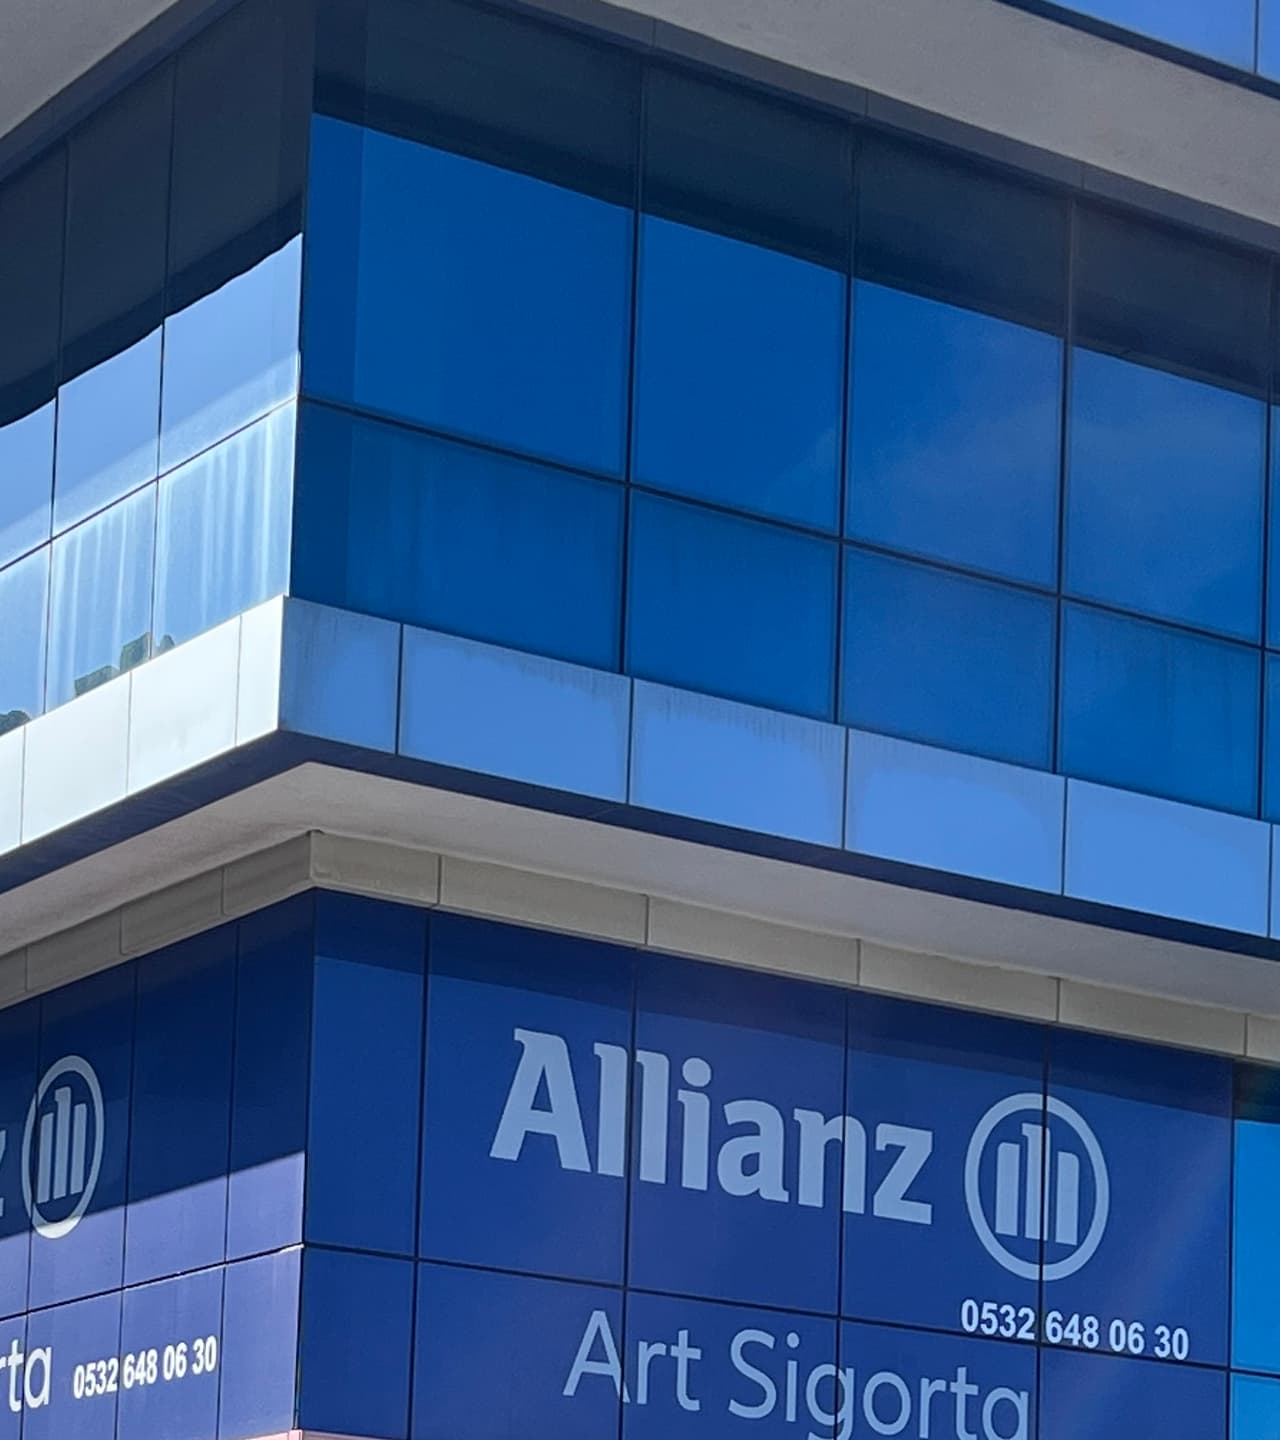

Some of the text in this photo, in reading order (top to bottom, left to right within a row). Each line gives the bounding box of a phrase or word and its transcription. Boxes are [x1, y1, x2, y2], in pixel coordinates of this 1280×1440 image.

[488, 1027, 934, 1225] Allianz
[73, 1335, 218, 1400] 0532 648 06 30
[563, 1309, 701, 1412] Art
[961, 1299, 1190, 1361] 0532 648 06 30
